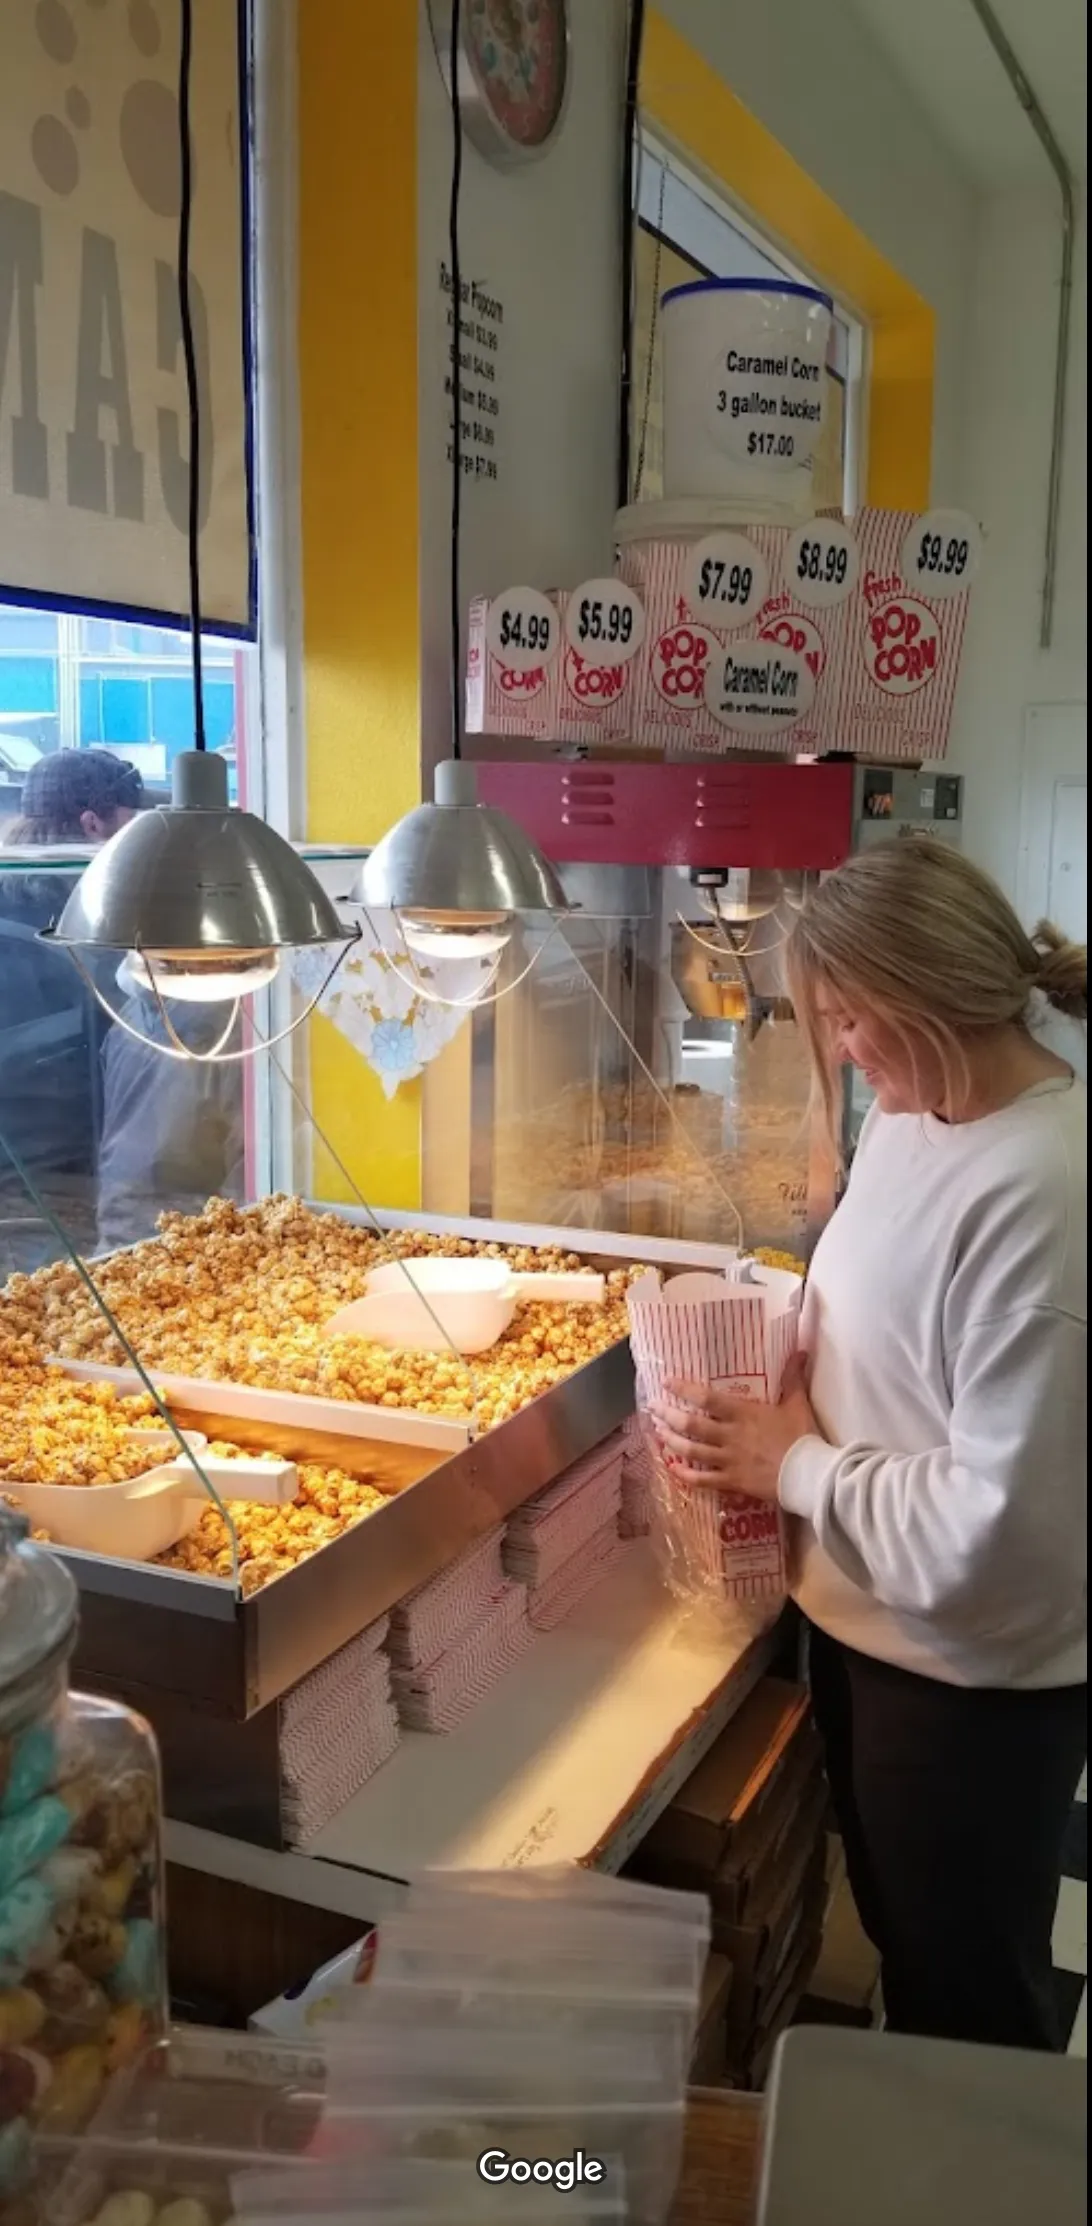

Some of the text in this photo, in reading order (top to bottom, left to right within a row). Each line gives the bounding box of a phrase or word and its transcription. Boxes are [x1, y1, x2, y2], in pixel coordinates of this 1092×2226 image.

[727, 350, 820, 382] Caramel Corn
[717, 390, 821, 422] 3 gallon bucket
[747, 431, 794, 457] $17.00
[797, 538, 848, 585] $8.99
[917, 532, 969, 576] $9.99
[699, 557, 753, 606] $7.99
[499, 610, 550, 651] $4.99
[578, 598, 633, 643] $5.99
[871, 605, 921, 650] POP
[659, 629, 708, 667] POP
[874, 636, 937, 682] CORN
[723, 656, 772, 695] Caramel
[771, 663, 799, 698] Corn
[719, 1509, 779, 1543] CORN
